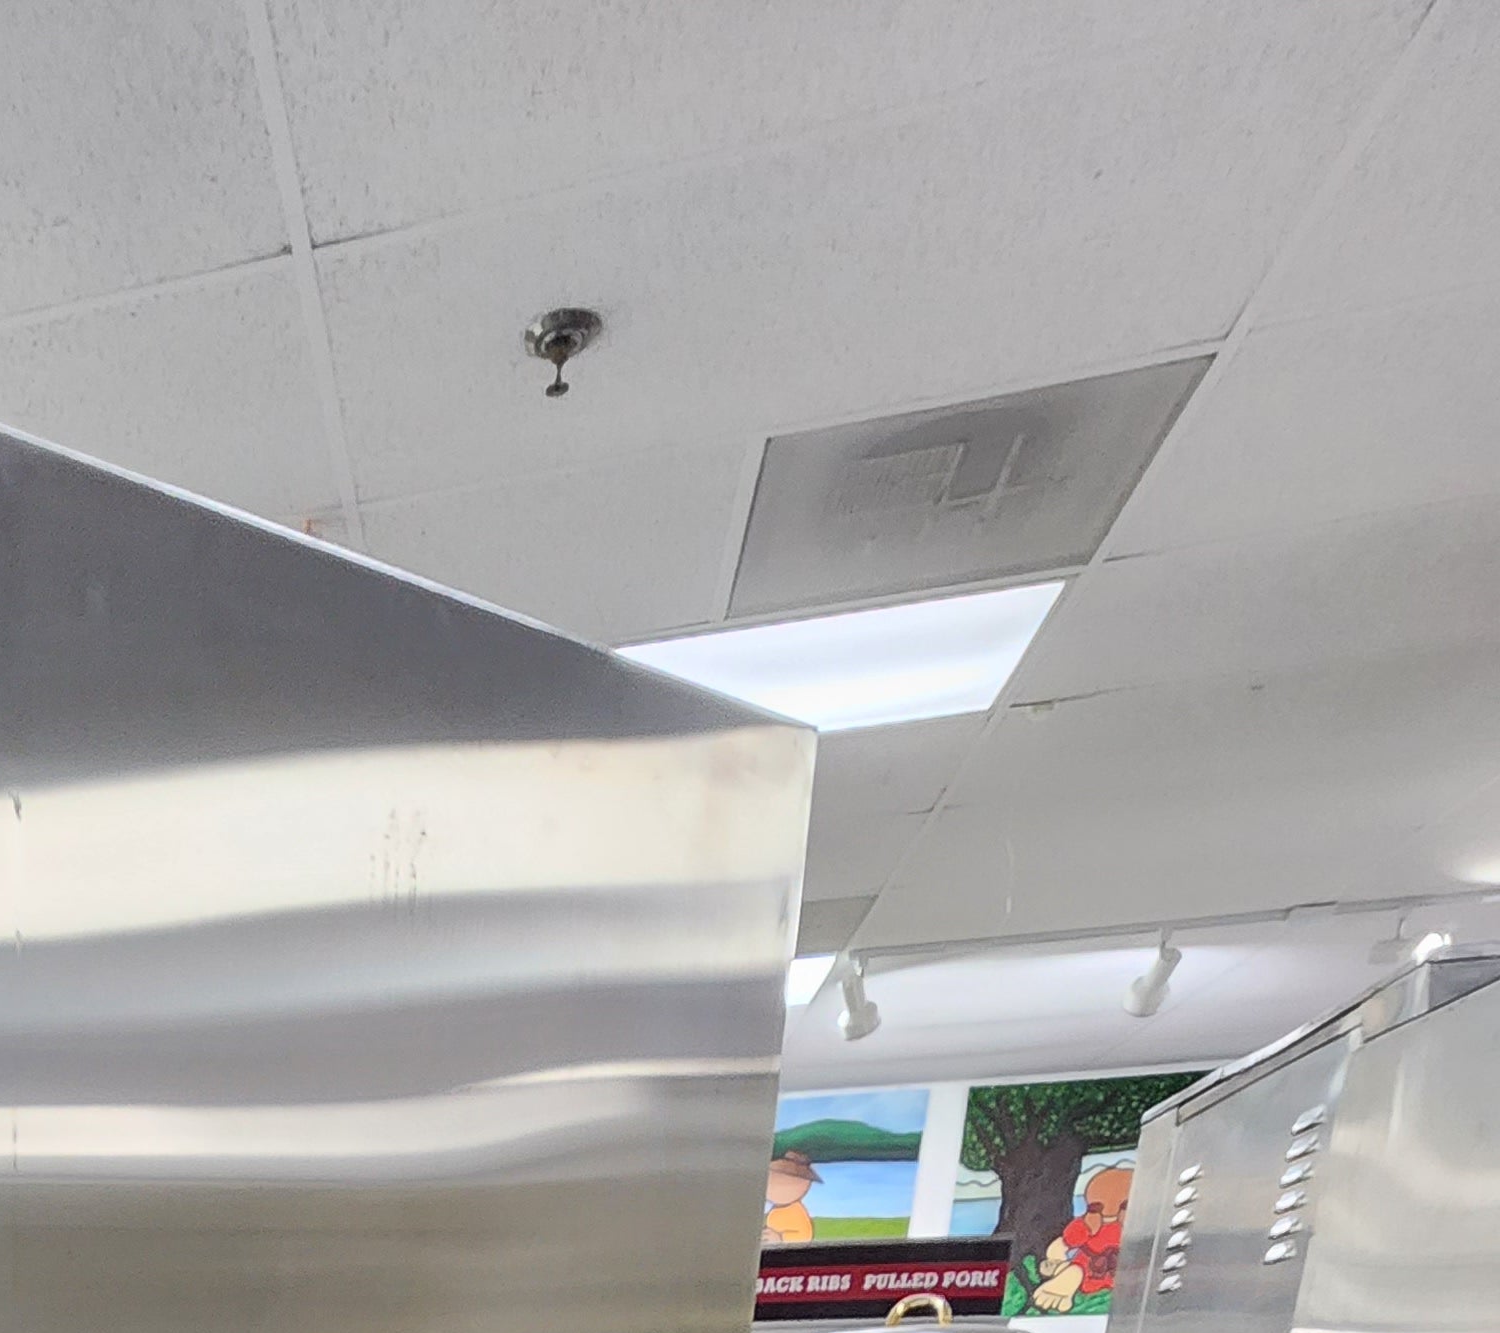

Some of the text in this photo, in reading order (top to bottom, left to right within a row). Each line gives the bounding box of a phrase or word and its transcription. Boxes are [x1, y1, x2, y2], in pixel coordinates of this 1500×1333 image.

[806, 1274, 852, 1293] RIBS
[863, 1272, 938, 1291] PULLED
[942, 1269, 1000, 1288] PORK
